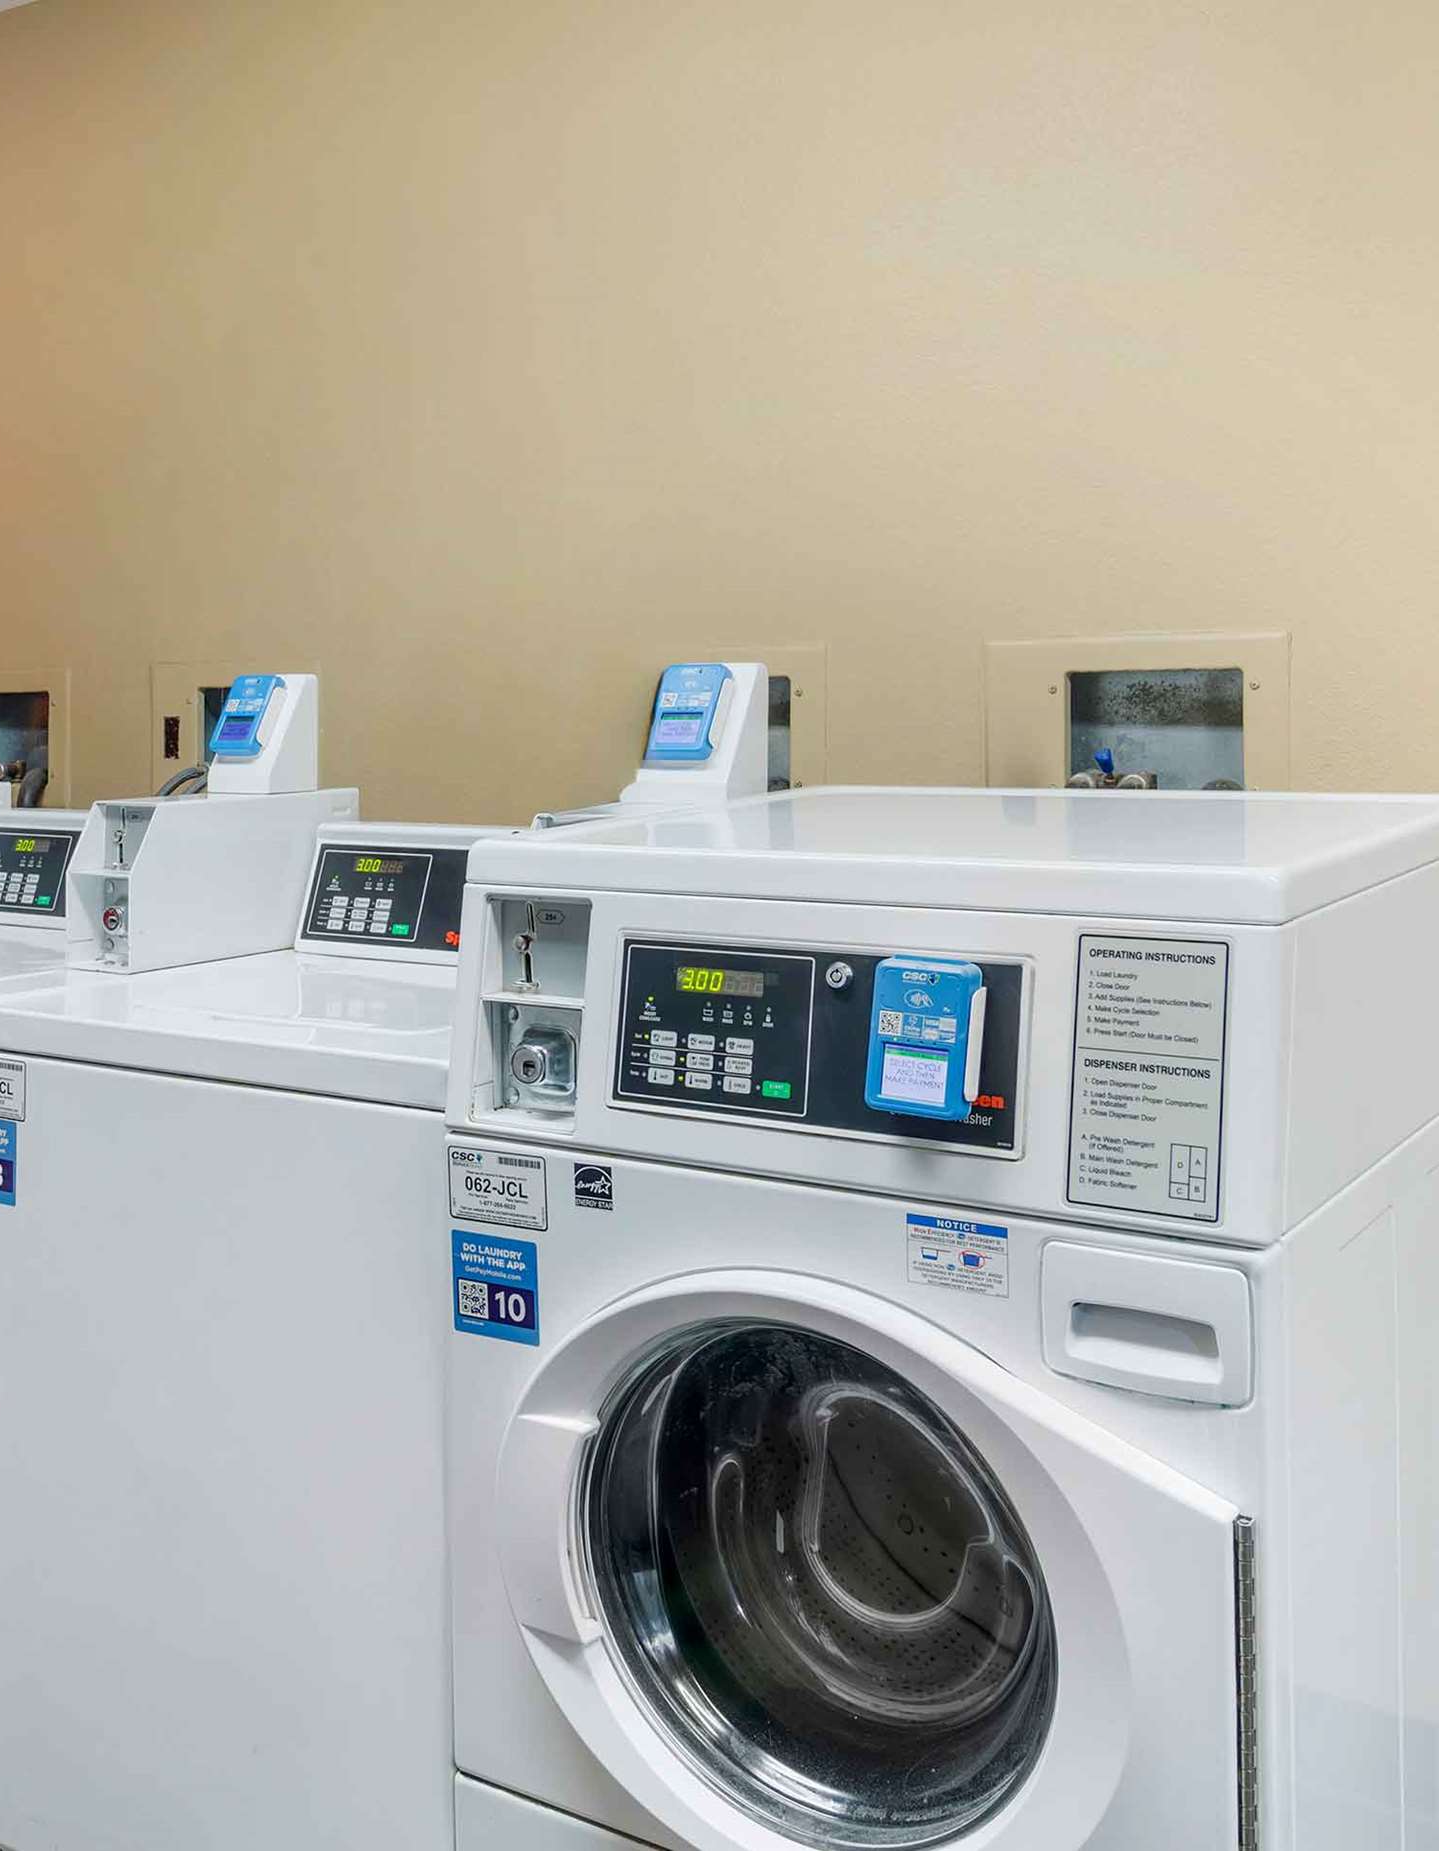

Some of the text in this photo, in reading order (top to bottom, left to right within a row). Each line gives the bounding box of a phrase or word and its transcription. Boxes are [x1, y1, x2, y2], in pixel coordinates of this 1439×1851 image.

[1088, 947, 1216, 966] OPERATING INSTRUCTIONS
[681, 969, 724, 992] 3.00
[1096, 970, 1113, 978] Load
[1113, 971, 1138, 981] Laundry
[1095, 982, 1113, 990] Close
[1114, 983, 1131, 991] Door
[1084, 1058, 1212, 1079] DISPENSER INSTRUCTIONS
[452, 1150, 476, 1162] CSC
[464, 1175, 529, 1199] 062-JCL
[936, 1218, 977, 1233] NOTICE
[462, 1242, 523, 1261] DO LAUNDRY
[460, 1251, 526, 1272] WITH THE APP
[494, 1290, 527, 1323] 10
